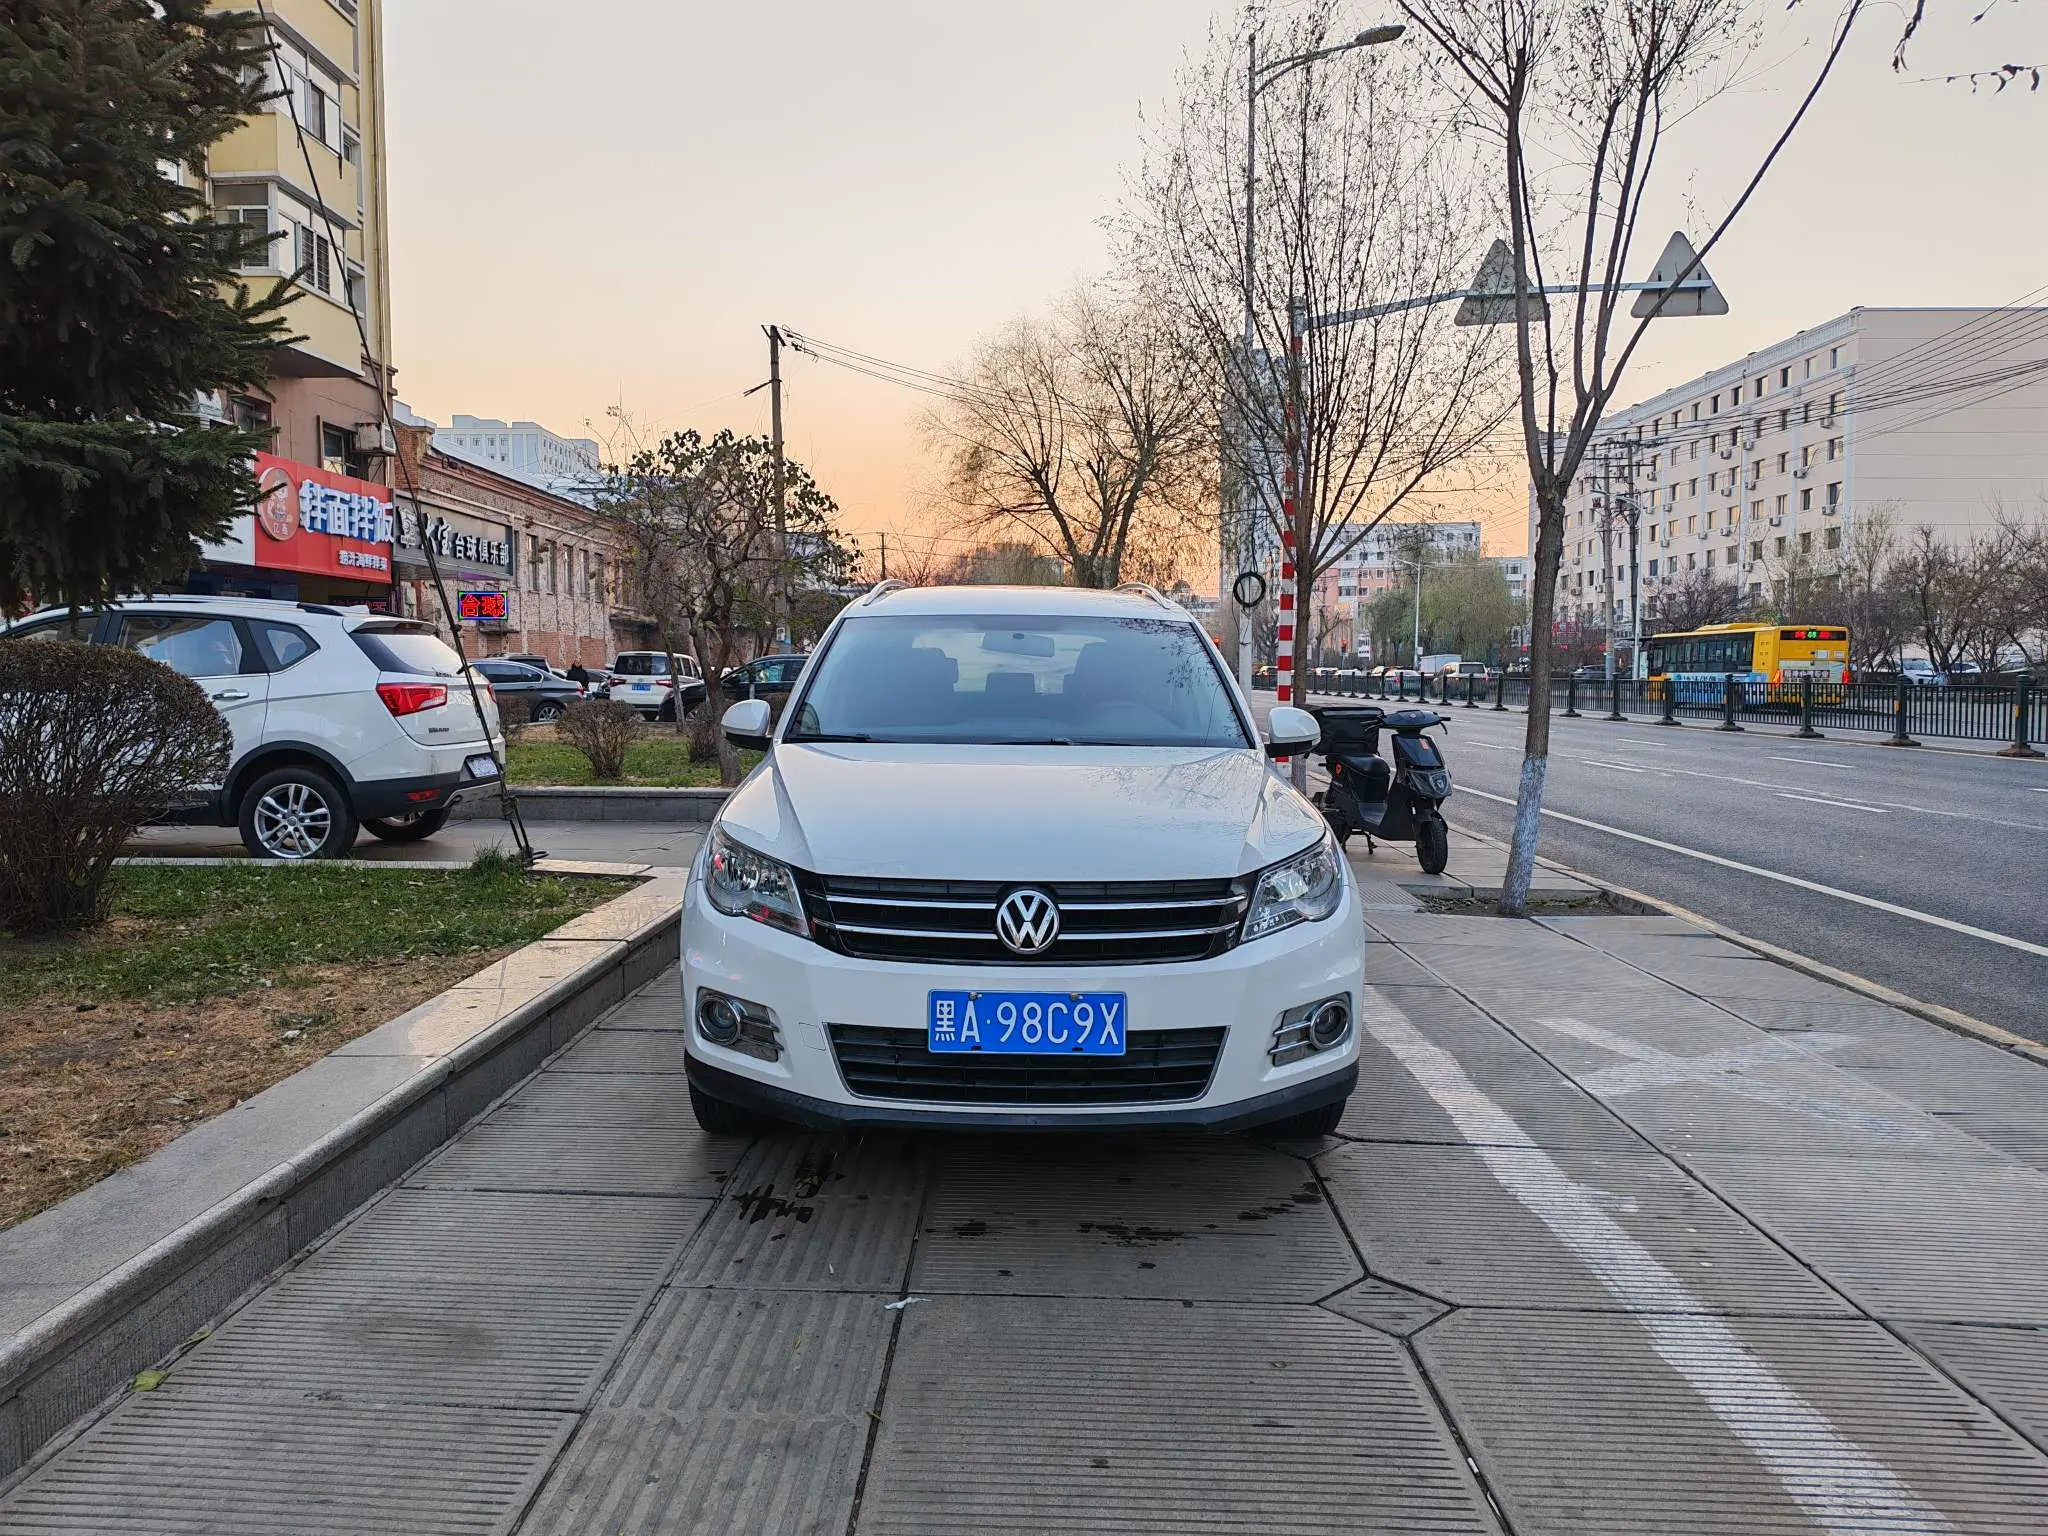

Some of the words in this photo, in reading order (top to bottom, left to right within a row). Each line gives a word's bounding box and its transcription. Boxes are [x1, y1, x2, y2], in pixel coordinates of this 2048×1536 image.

[299, 479, 394, 545] 拌面拌饭
[461, 594, 505, 617] 台球
